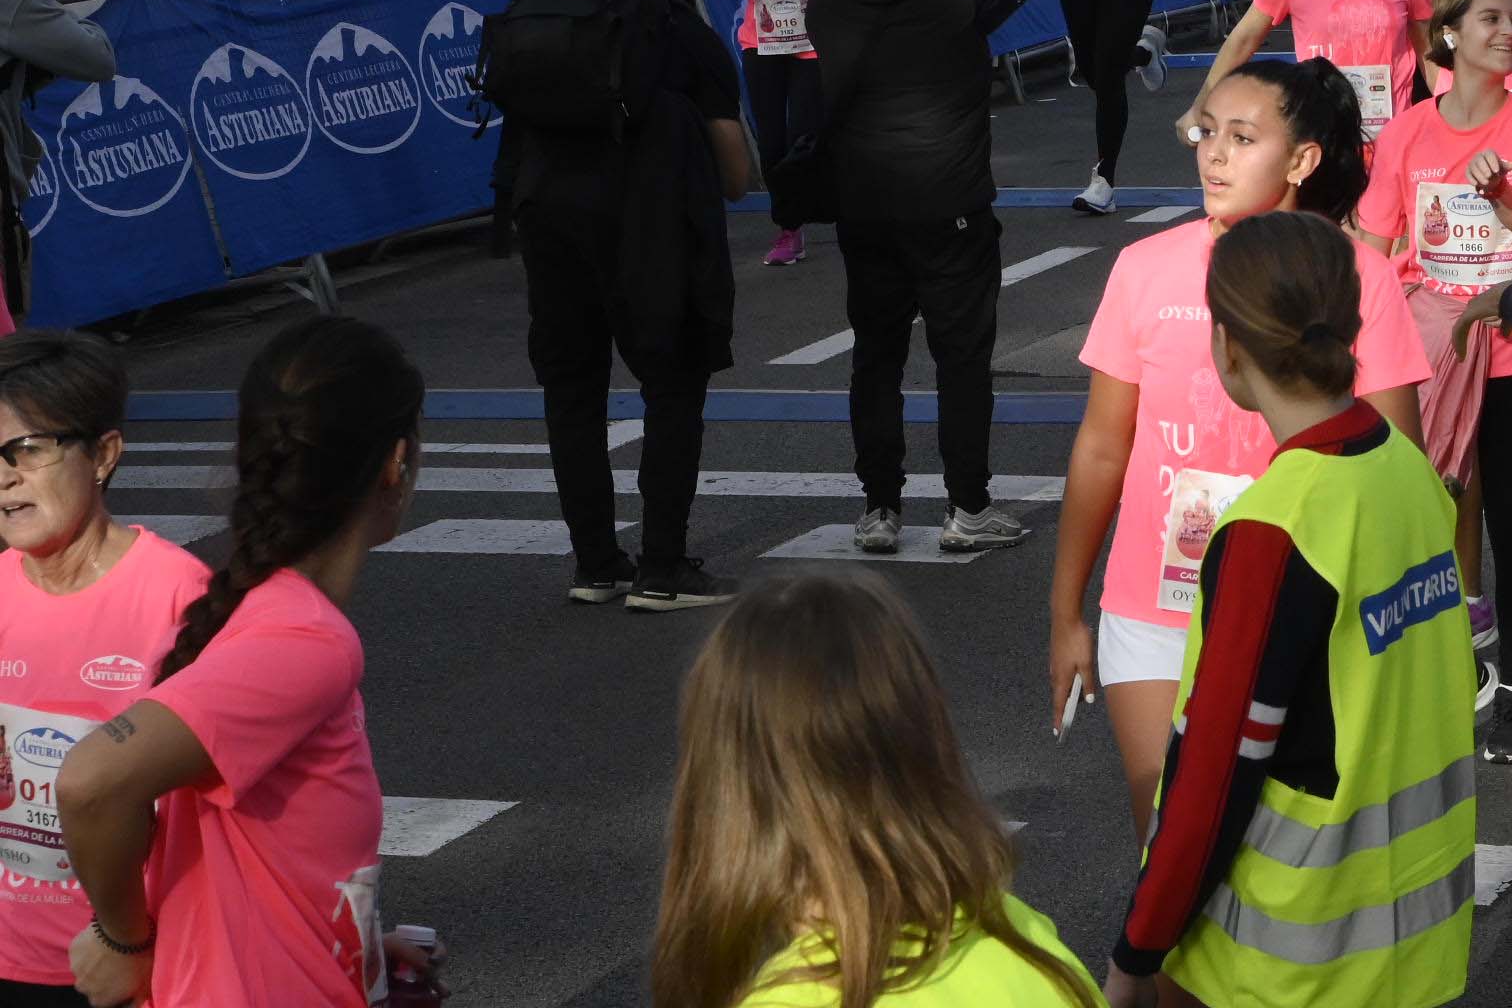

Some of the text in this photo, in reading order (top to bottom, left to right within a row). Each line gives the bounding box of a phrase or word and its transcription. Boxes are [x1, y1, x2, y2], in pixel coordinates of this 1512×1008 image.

[775, 18, 797, 28] 016
[316, 76, 417, 127] ASTURIANA
[202, 100, 306, 152] ASTURIANA
[1453, 224, 1490, 239] 016
[1460, 243, 1483, 252] 1866
[1159, 421, 1196, 456] TU
[31, 832, 44, 842] DE
[45, 835, 56, 845] LA
